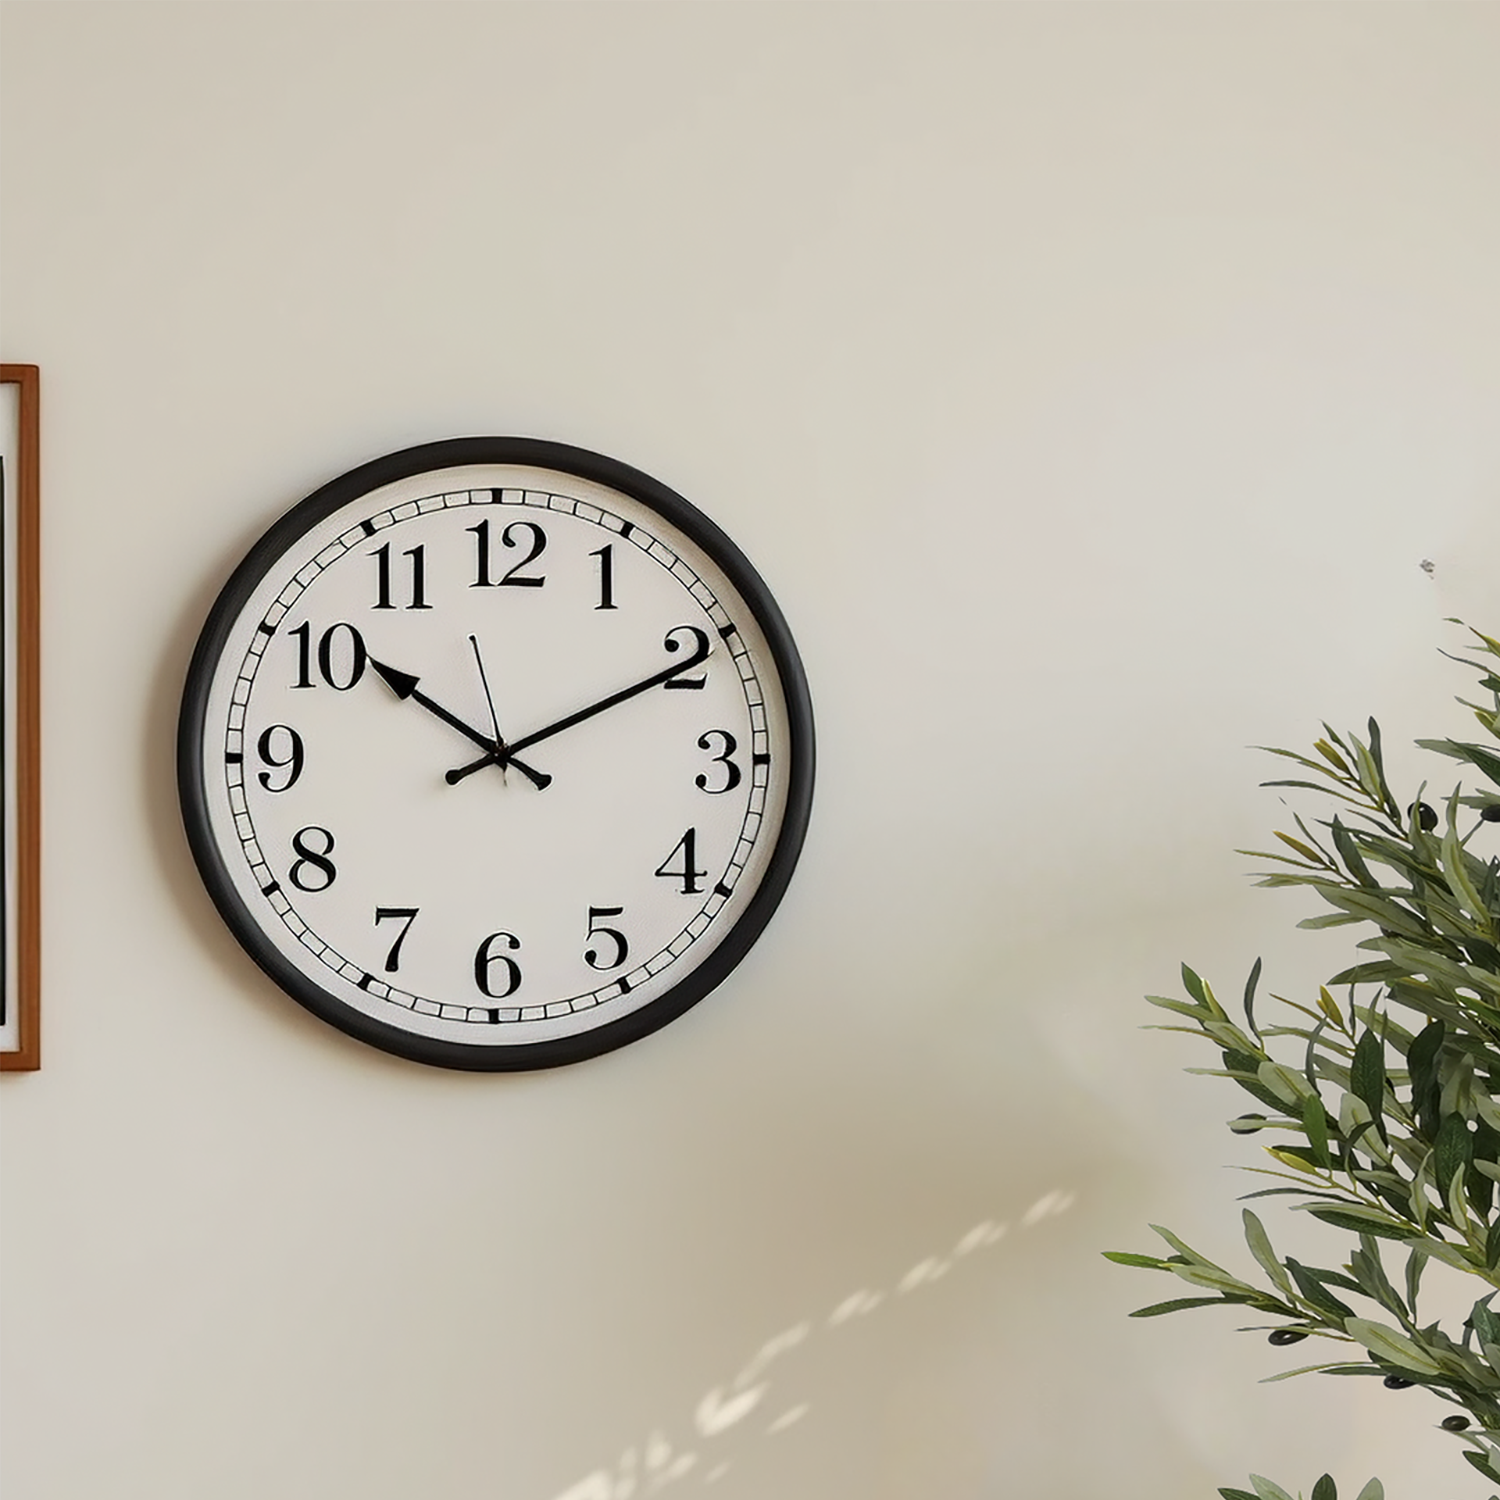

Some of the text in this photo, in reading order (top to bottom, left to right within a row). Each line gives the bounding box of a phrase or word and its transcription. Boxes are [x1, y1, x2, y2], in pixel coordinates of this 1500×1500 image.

[367, 542, 434, 610] 11
[466, 519, 547, 588] 12
[588, 543, 618, 611] 1
[287, 620, 366, 690] 10
[664, 625, 712, 690] 2
[257, 724, 304, 793] 9
[695, 729, 742, 795] 3
[288, 826, 337, 893] 8
[654, 827, 708, 895] 4
[374, 907, 420, 973] 7
[474, 931, 522, 999] 6
[583, 906, 629, 971] 5
